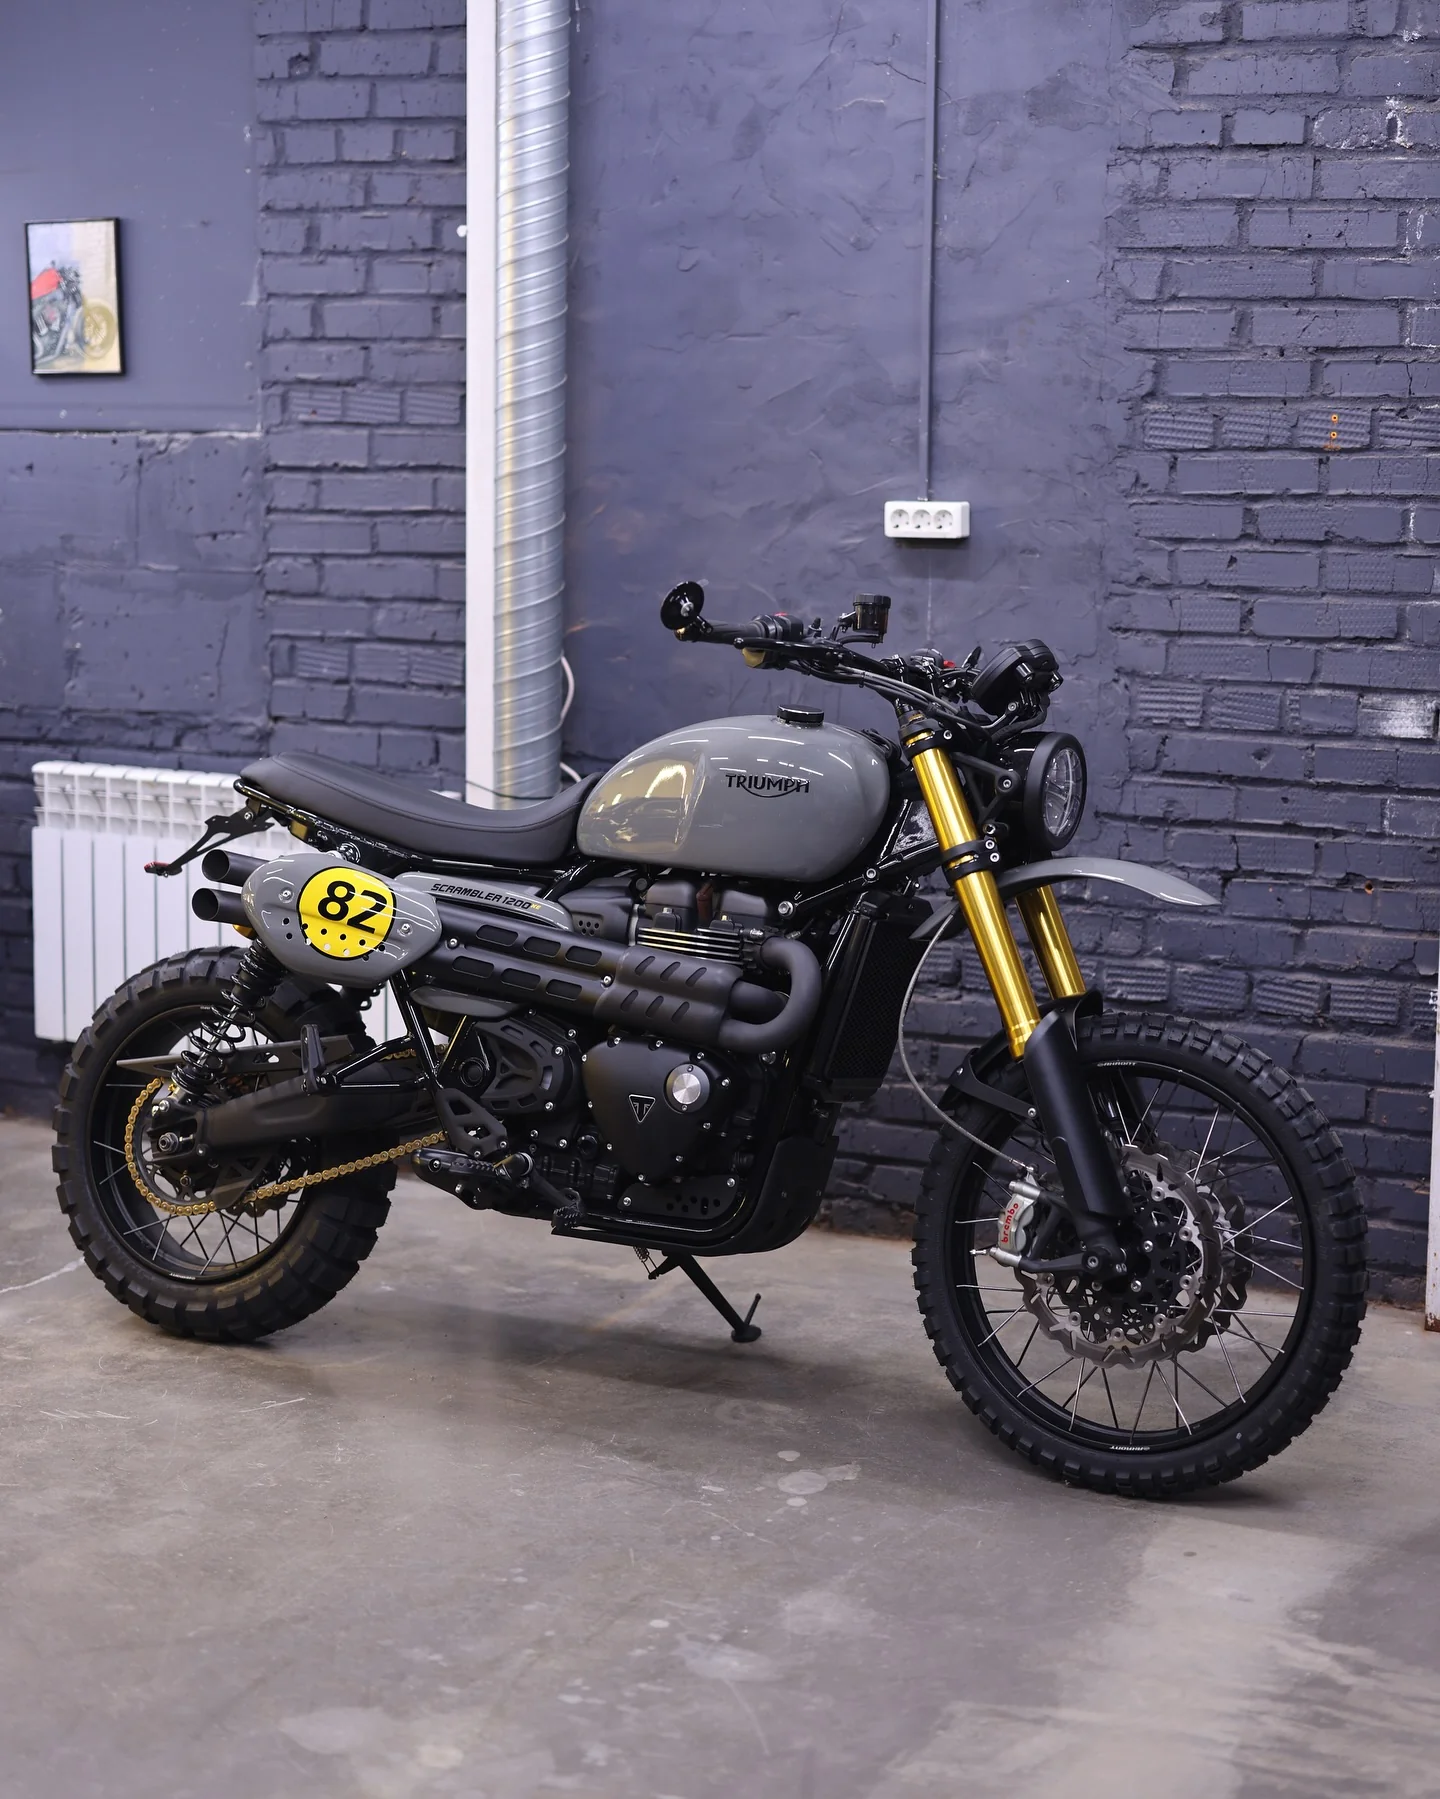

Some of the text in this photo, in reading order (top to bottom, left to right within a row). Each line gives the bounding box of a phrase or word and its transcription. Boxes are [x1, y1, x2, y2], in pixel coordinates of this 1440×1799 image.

[725, 774, 810, 798] TRIUMPH
[317, 880, 388, 935] 82
[430, 883, 503, 904] SCRAMBLER
[1001, 1202, 1019, 1244] brembo
